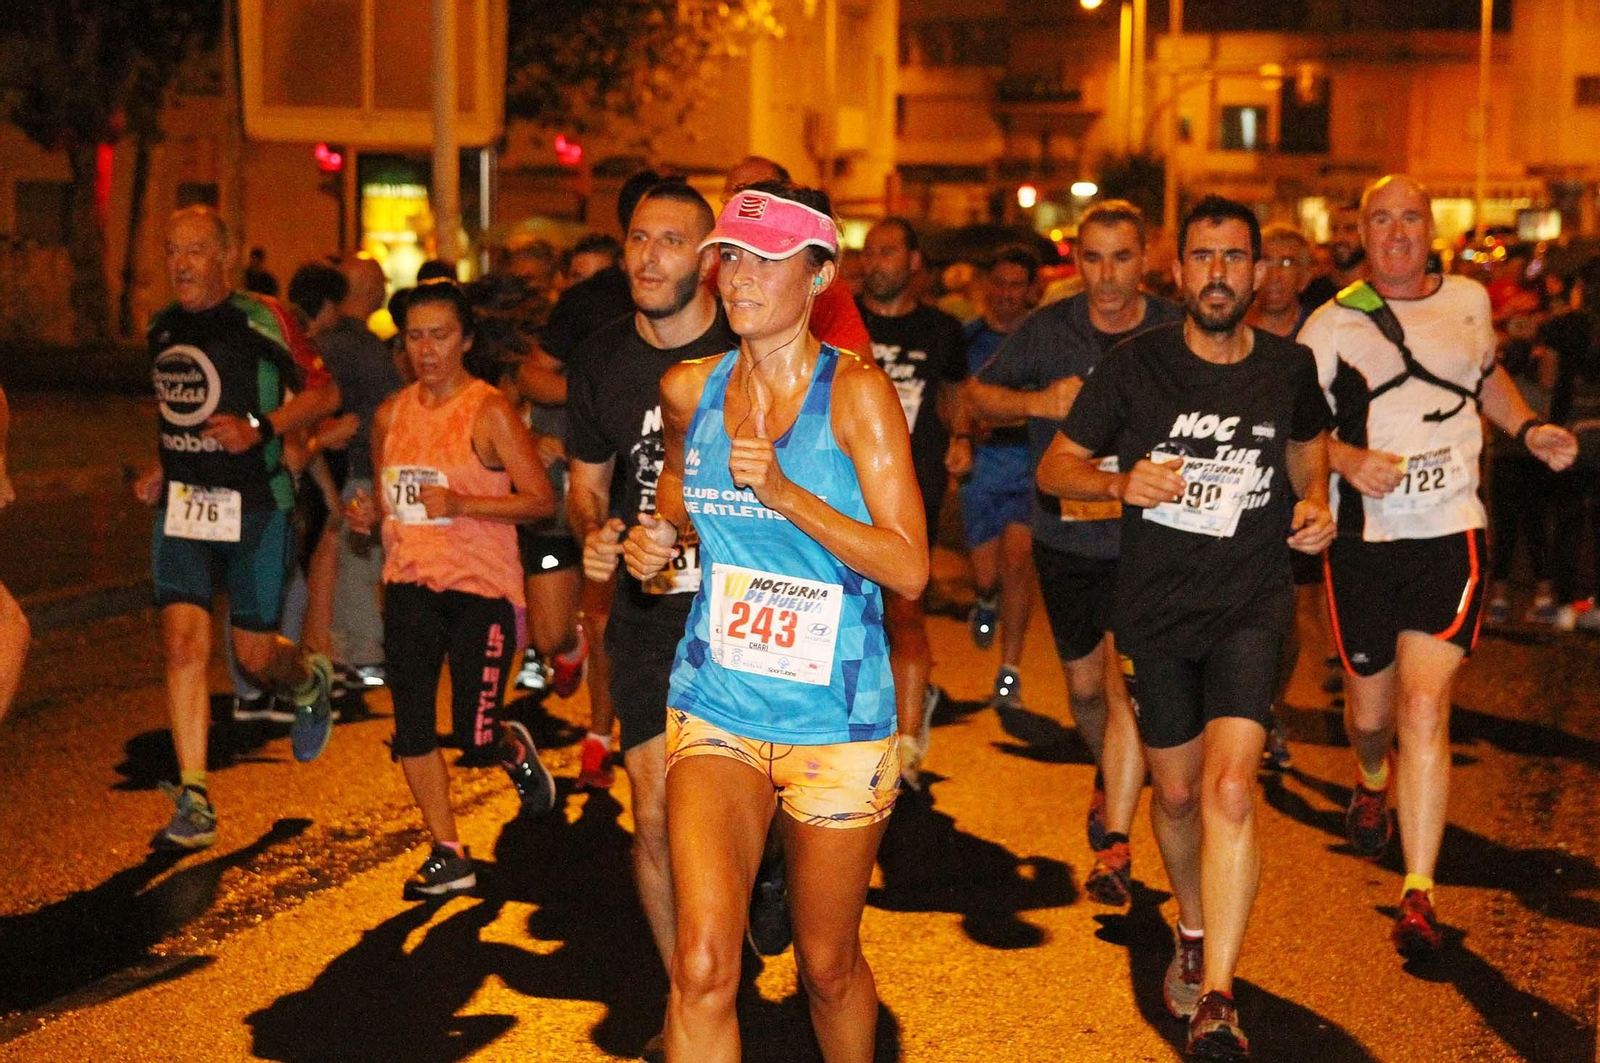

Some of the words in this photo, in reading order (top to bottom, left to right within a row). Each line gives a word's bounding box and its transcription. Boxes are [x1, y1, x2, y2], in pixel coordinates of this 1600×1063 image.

[1169, 411, 1241, 442] NOC
[393, 484, 423, 505] 78
[1172, 481, 1222, 511] 90
[185, 500, 218, 522] 776
[664, 543, 700, 571] 87
[742, 590, 766, 604] DE
[766, 593, 823, 615] HUELVA
[749, 577, 828, 600] NOCTURNA
[727, 601, 798, 649] 243
[485, 623, 505, 657] UP
[748, 641, 769, 653] CHARI
[474, 666, 500, 747] STYLE
